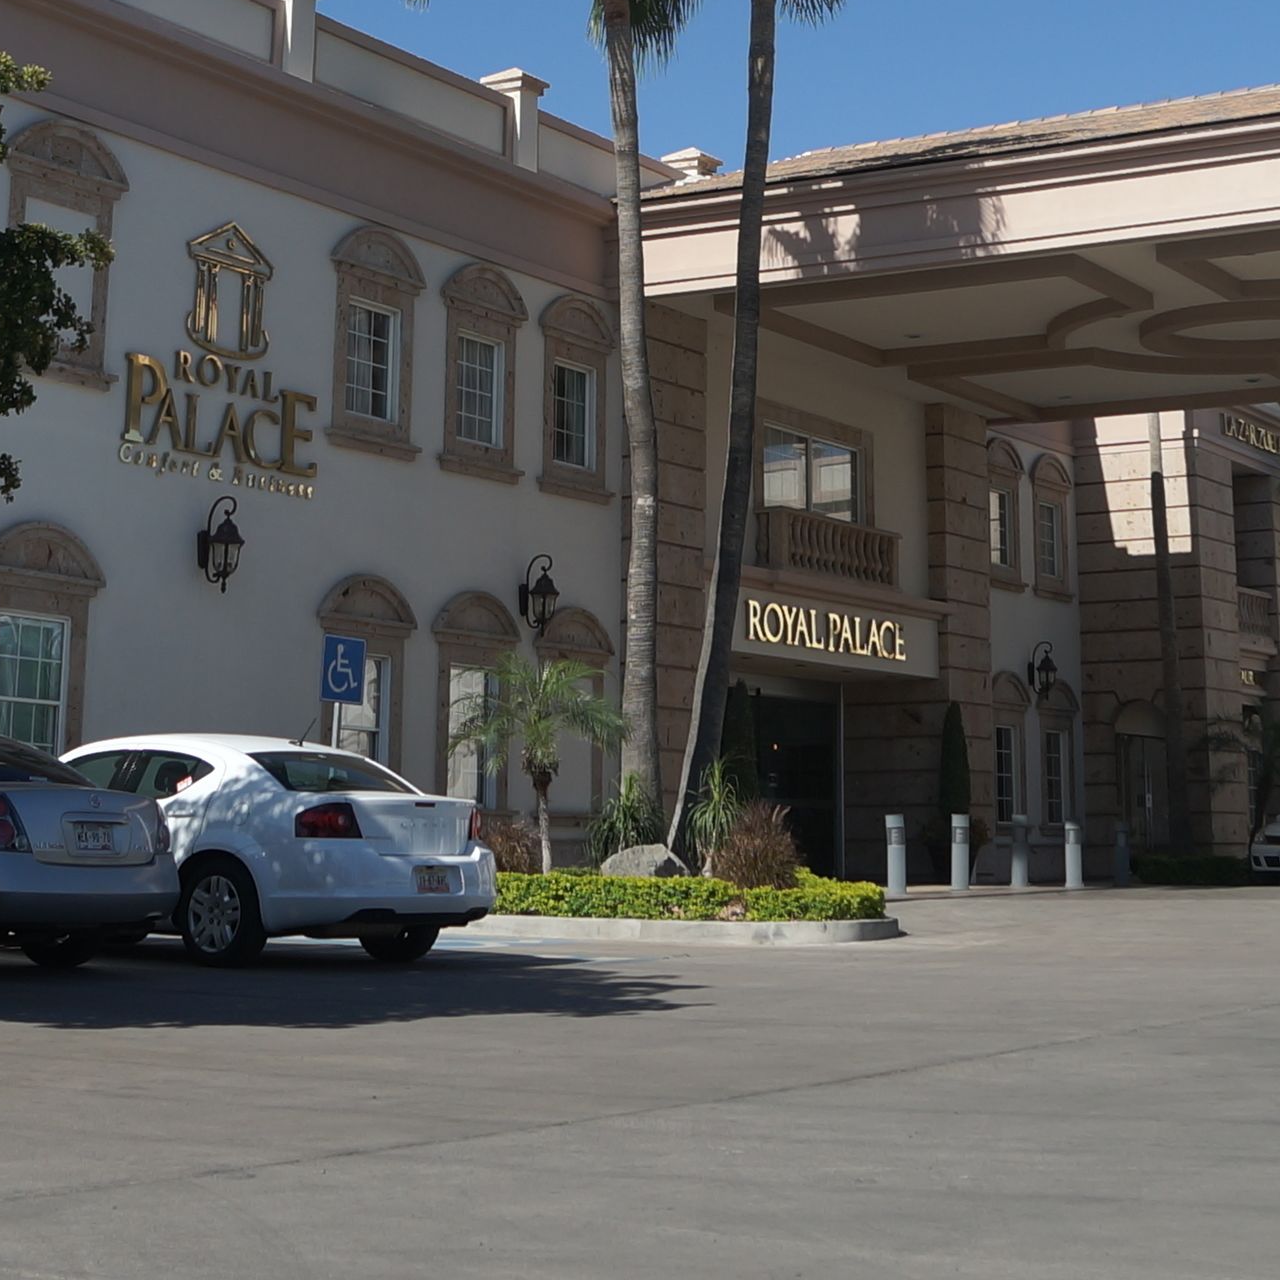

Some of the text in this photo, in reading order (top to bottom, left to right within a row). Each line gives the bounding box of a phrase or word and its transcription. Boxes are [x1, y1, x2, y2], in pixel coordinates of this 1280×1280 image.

[175, 350, 279, 404] ROYAL
[124, 352, 318, 478] PALACE
[208, 463, 223, 481] &
[747, 599, 907, 661] ROYAL PALACE
